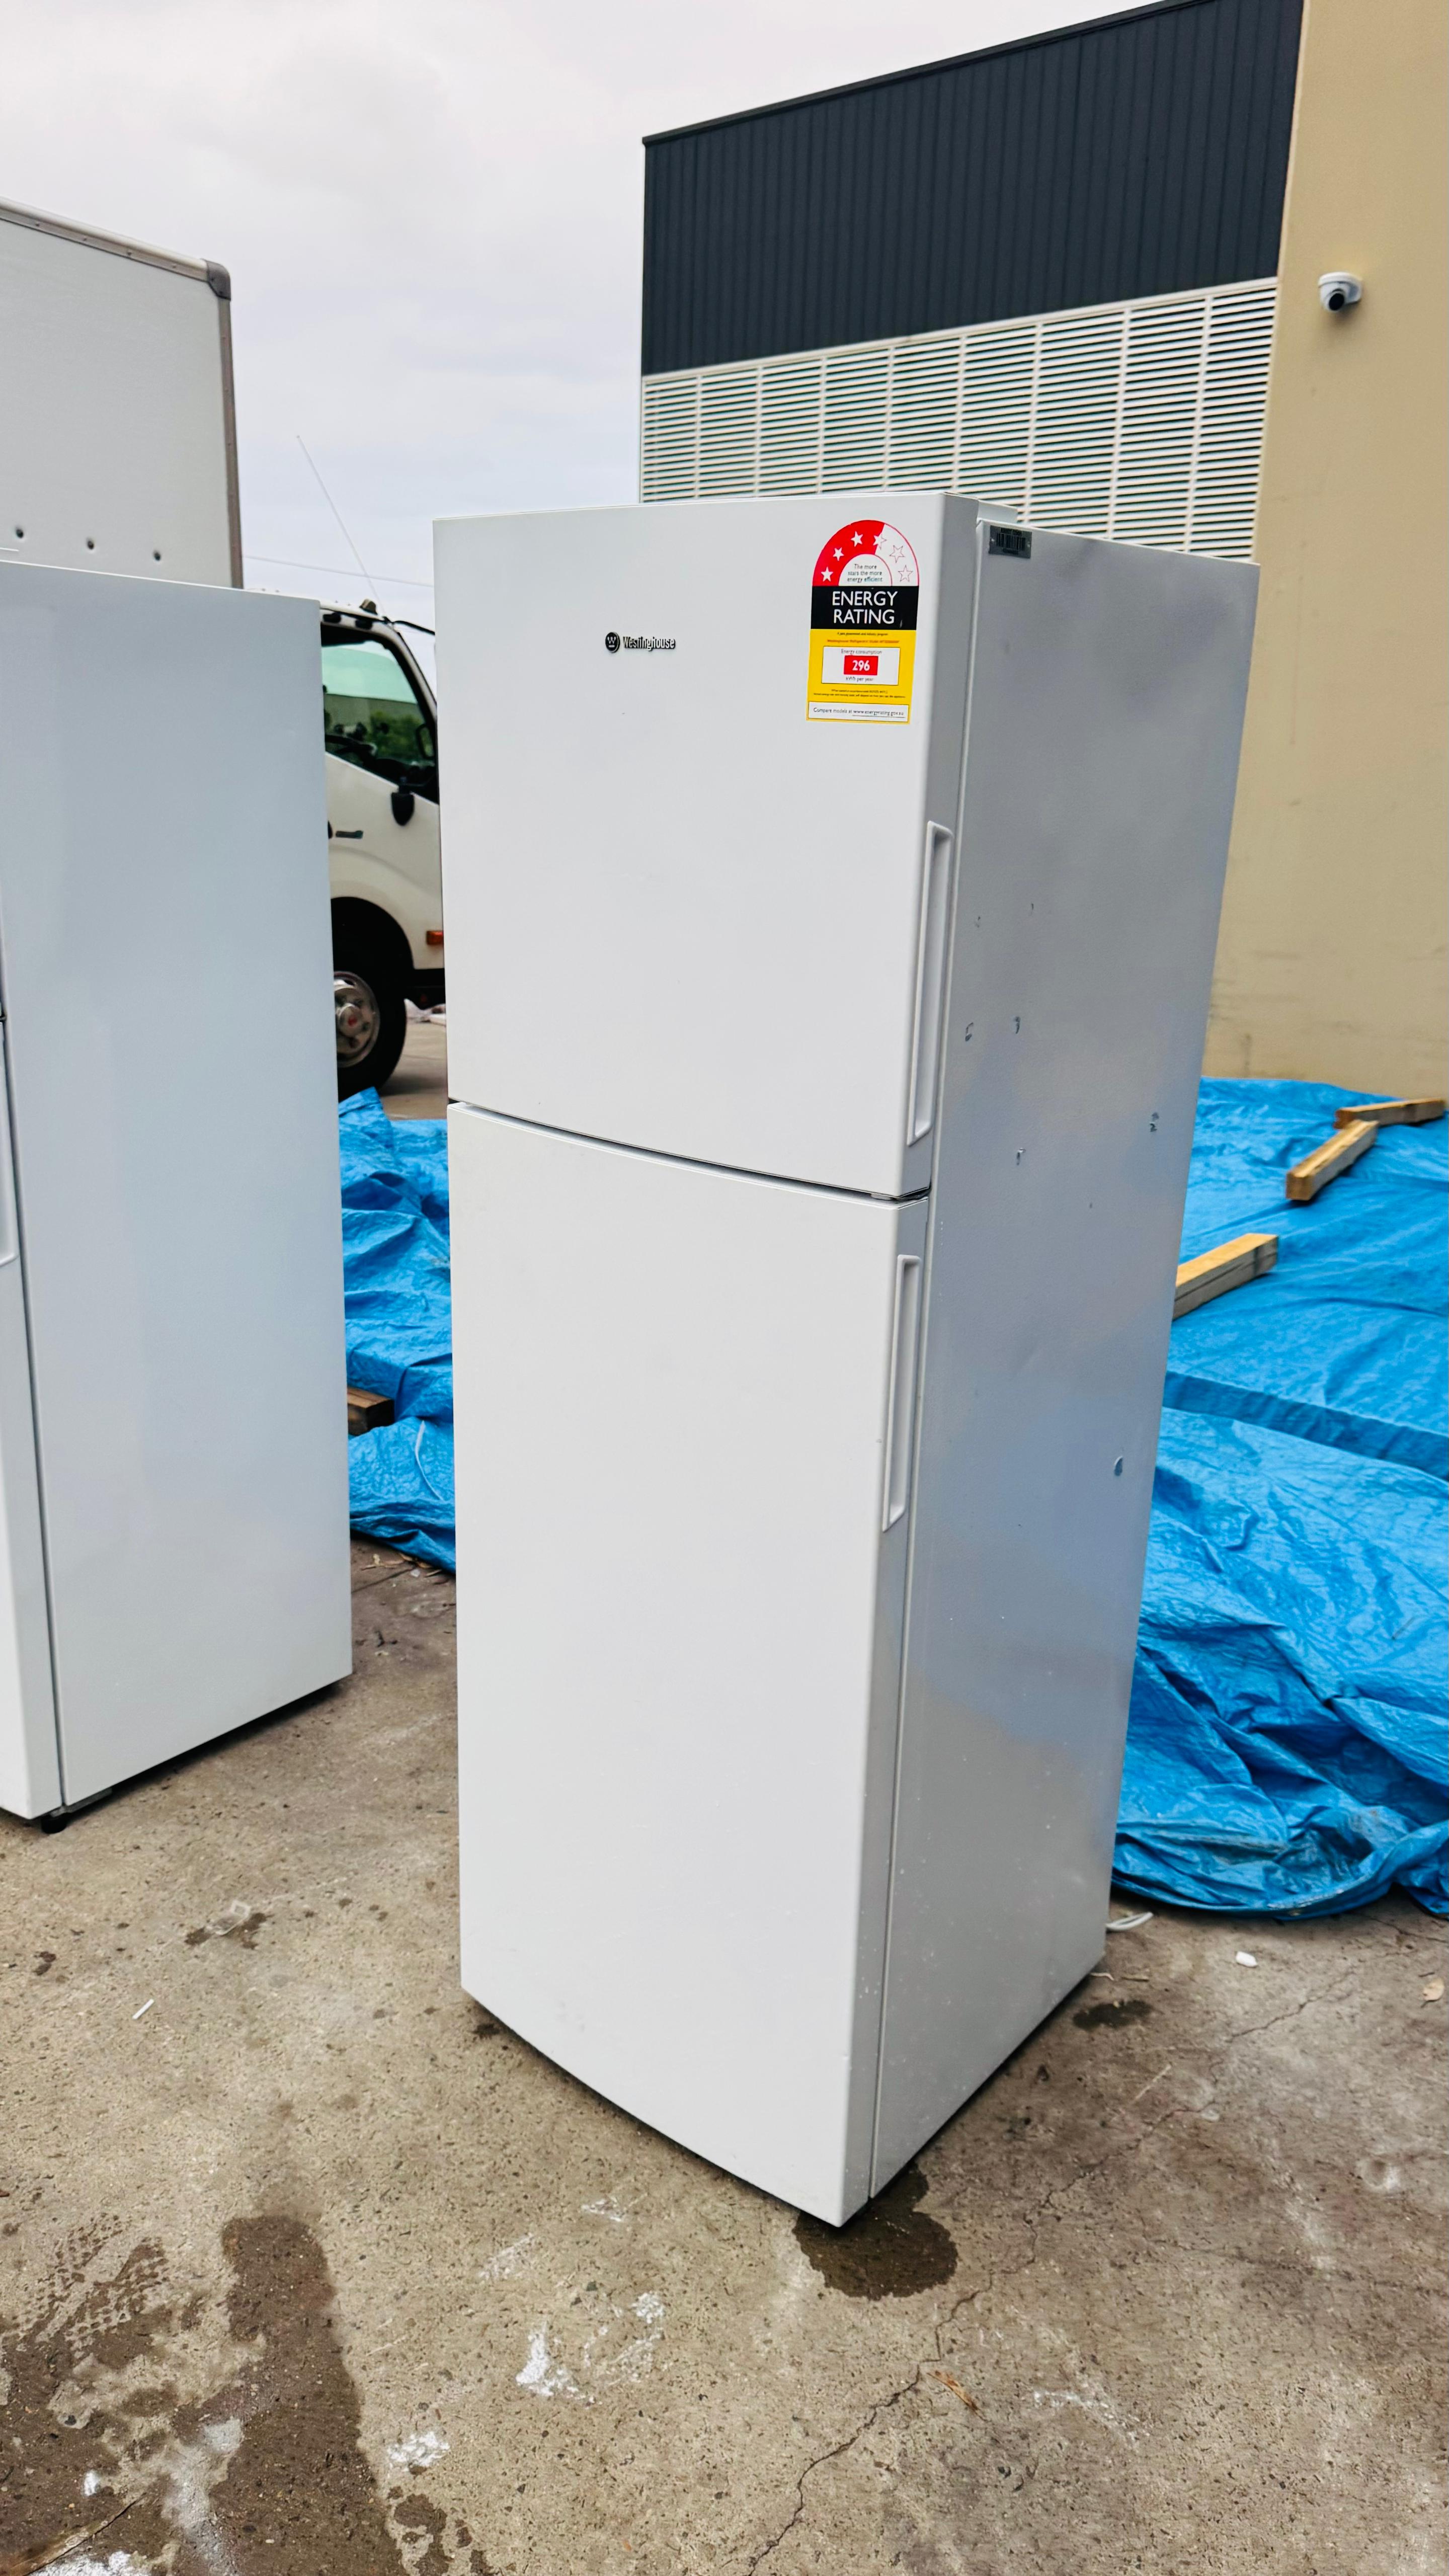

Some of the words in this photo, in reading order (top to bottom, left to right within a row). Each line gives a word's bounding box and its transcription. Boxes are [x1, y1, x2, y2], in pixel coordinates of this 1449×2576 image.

[832, 591, 898, 606] ENERGY
[833, 609, 895, 624] RATING
[623, 636, 676, 652] Westinghouse
[852, 660, 870, 671] 296
